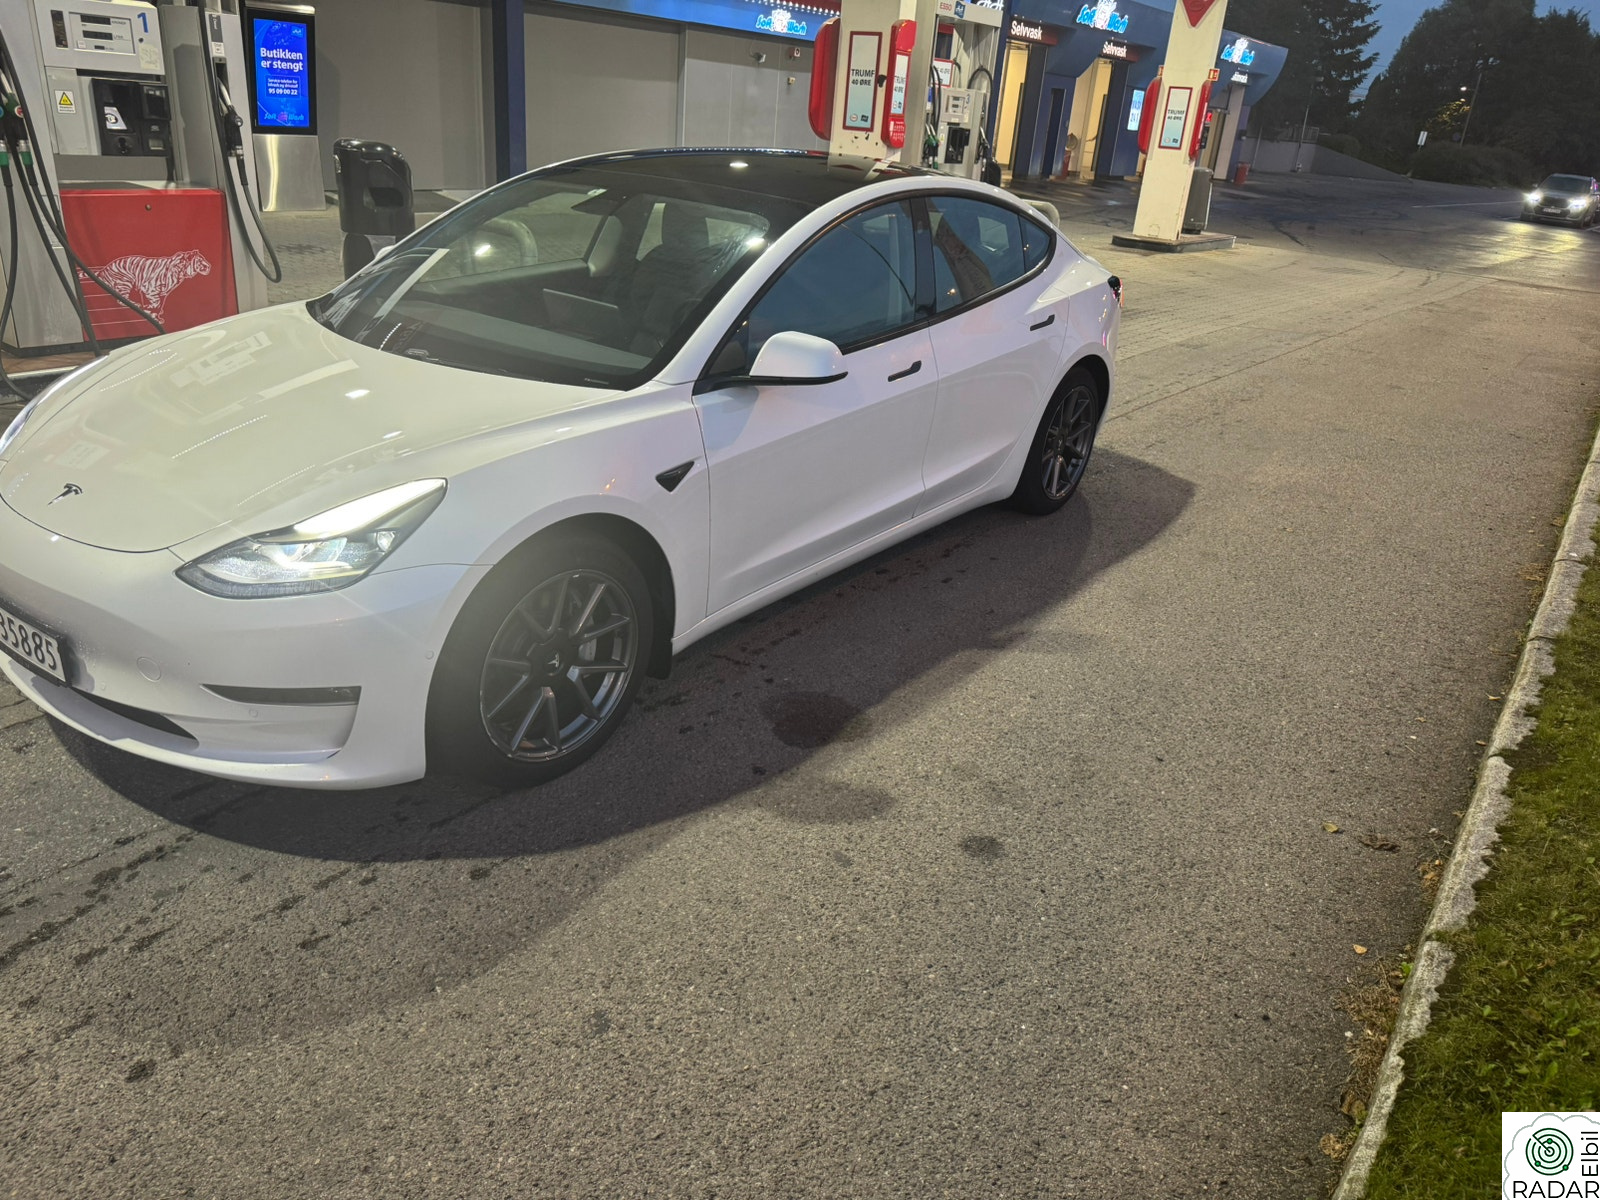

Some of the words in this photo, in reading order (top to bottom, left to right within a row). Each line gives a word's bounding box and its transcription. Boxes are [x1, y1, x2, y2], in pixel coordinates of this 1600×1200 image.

[137, 12, 149, 34] 1
[1011, 20, 1042, 40] Selvvask
[260, 48, 303, 60] Butikken
[1103, 41, 1127, 57] Selvvask
[261, 60, 271, 68] er
[273, 61, 303, 72] stengt
[851, 69, 875, 77] TRUMF
